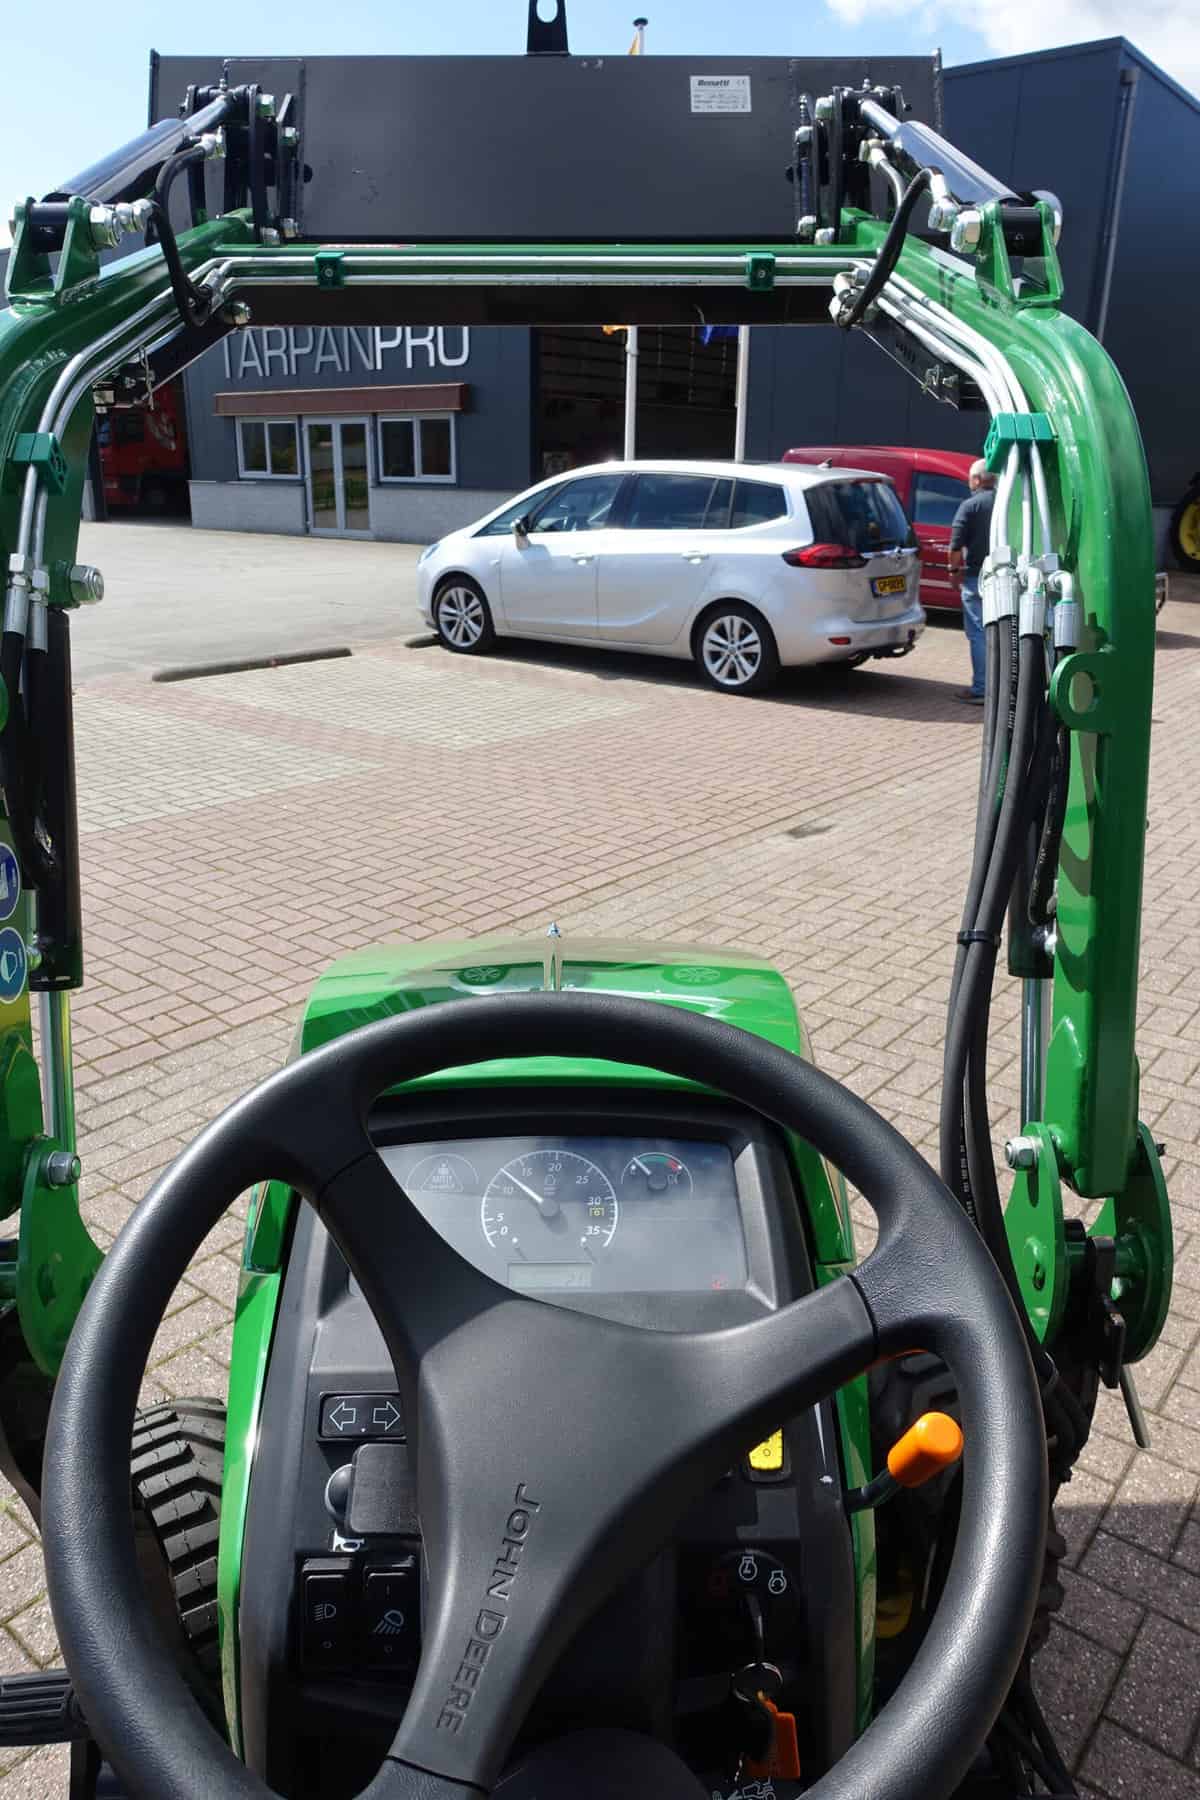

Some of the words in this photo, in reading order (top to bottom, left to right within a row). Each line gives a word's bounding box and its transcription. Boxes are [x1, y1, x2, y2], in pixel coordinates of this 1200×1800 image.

[521, 1167, 533, 1177] 15
[548, 1162, 562, 1172] 20
[575, 1175, 589, 1185] 25
[587, 1196, 602, 1206] 30
[496, 1212, 505, 1222] 5
[585, 1225, 601, 1236] 35
[486, 1482, 542, 1601] JOHN
[436, 1608, 508, 1735] DEERE
